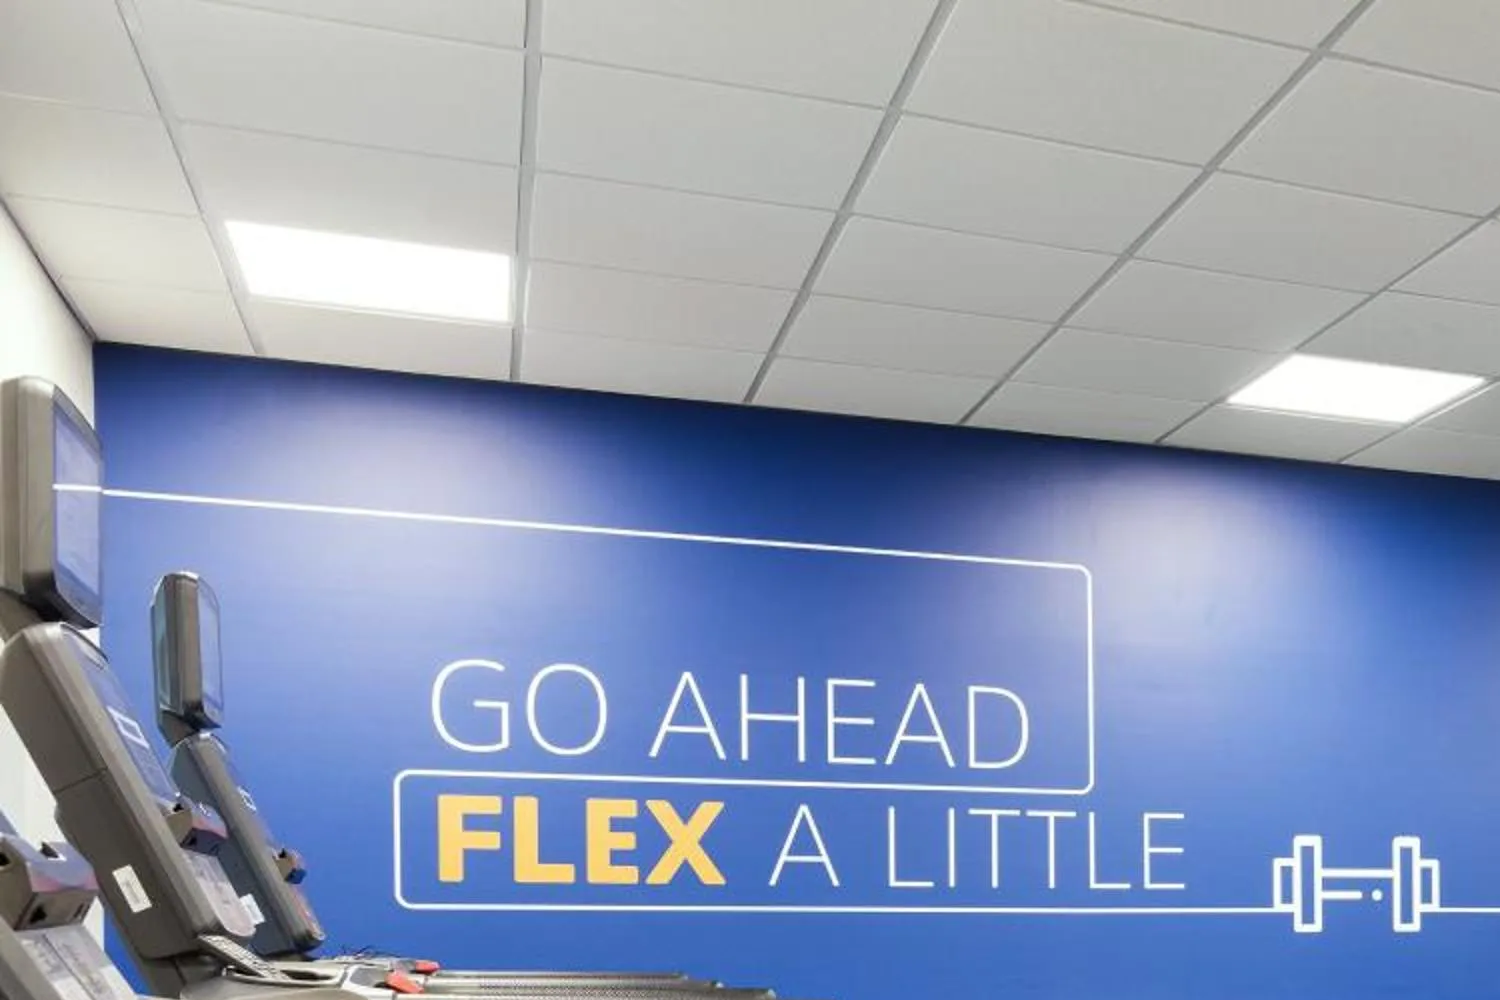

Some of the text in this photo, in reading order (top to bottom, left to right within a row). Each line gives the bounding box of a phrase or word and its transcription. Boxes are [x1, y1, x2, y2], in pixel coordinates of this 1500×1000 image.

[431, 659, 1029, 769] GO AHEAD
[437, 794, 1185, 889] FLEX A LITTLE
